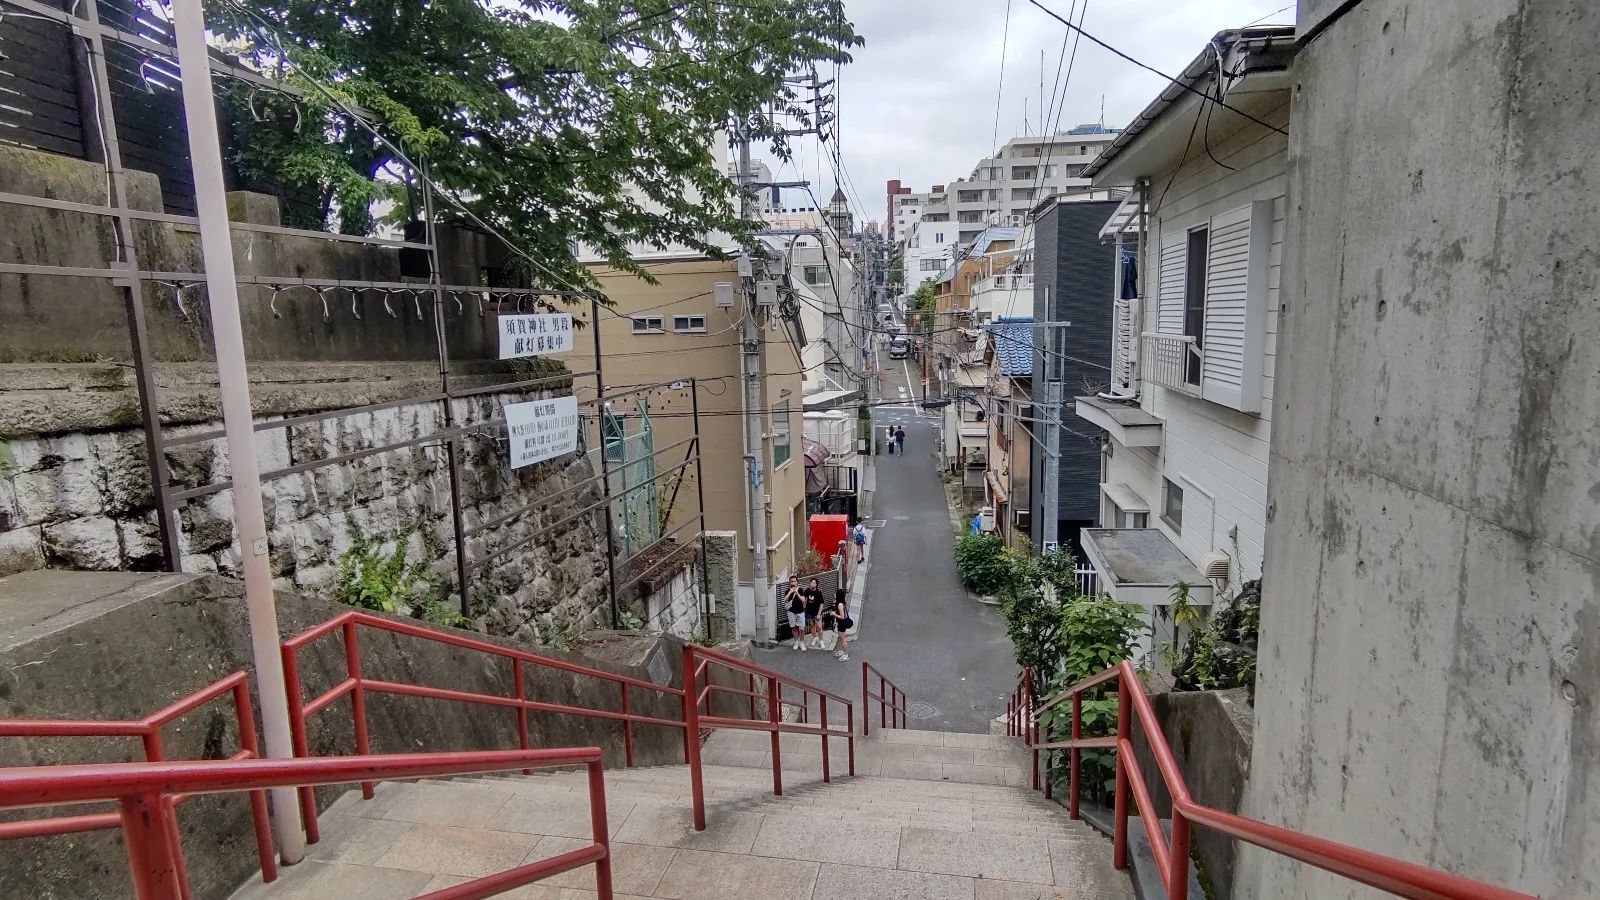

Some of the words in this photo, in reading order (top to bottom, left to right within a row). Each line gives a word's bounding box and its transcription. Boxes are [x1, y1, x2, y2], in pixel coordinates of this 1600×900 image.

[515, 335, 563, 354] 献灯募集中
